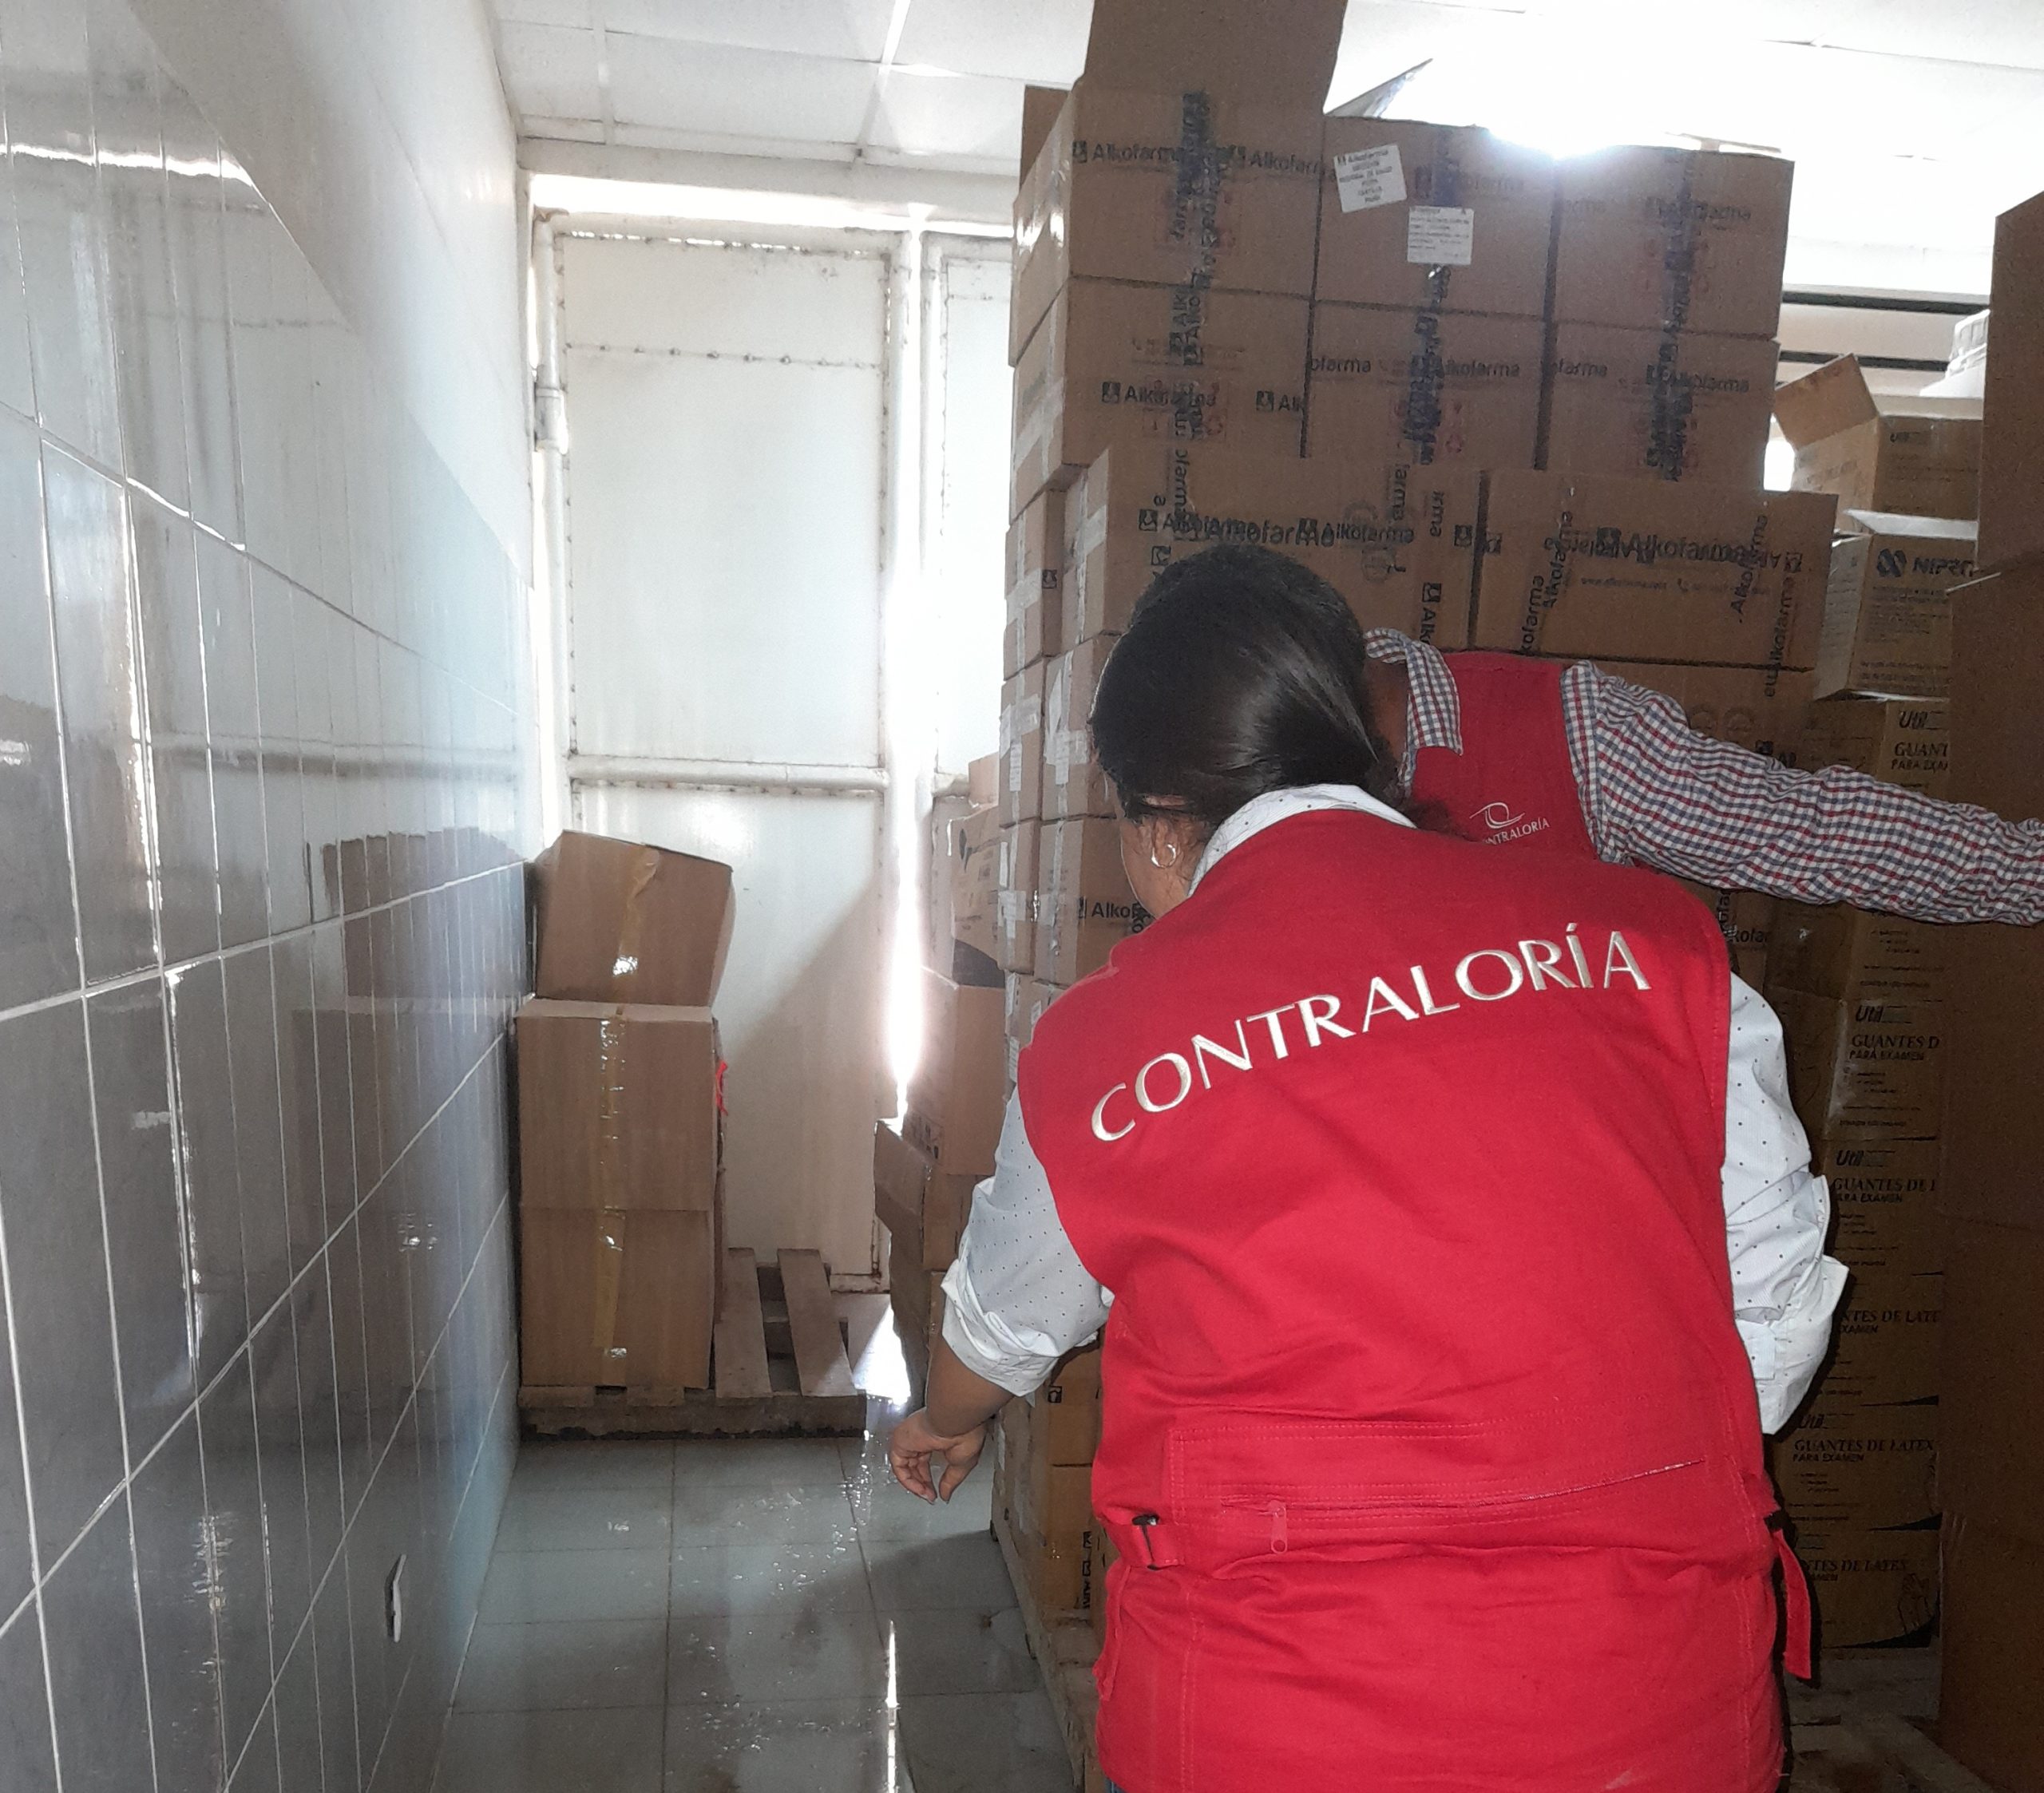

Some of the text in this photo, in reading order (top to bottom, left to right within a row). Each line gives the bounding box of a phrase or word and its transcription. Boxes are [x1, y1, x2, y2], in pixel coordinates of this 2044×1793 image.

[1420, 607, 1436, 643] Alk
[1483, 817, 1551, 845] NTRALORÍA
[1091, 923, 1652, 1142] CONTRALORÍA
[1851, 1033, 1927, 1049] GUANTES
[1905, 1310, 1943, 1323] LATE
